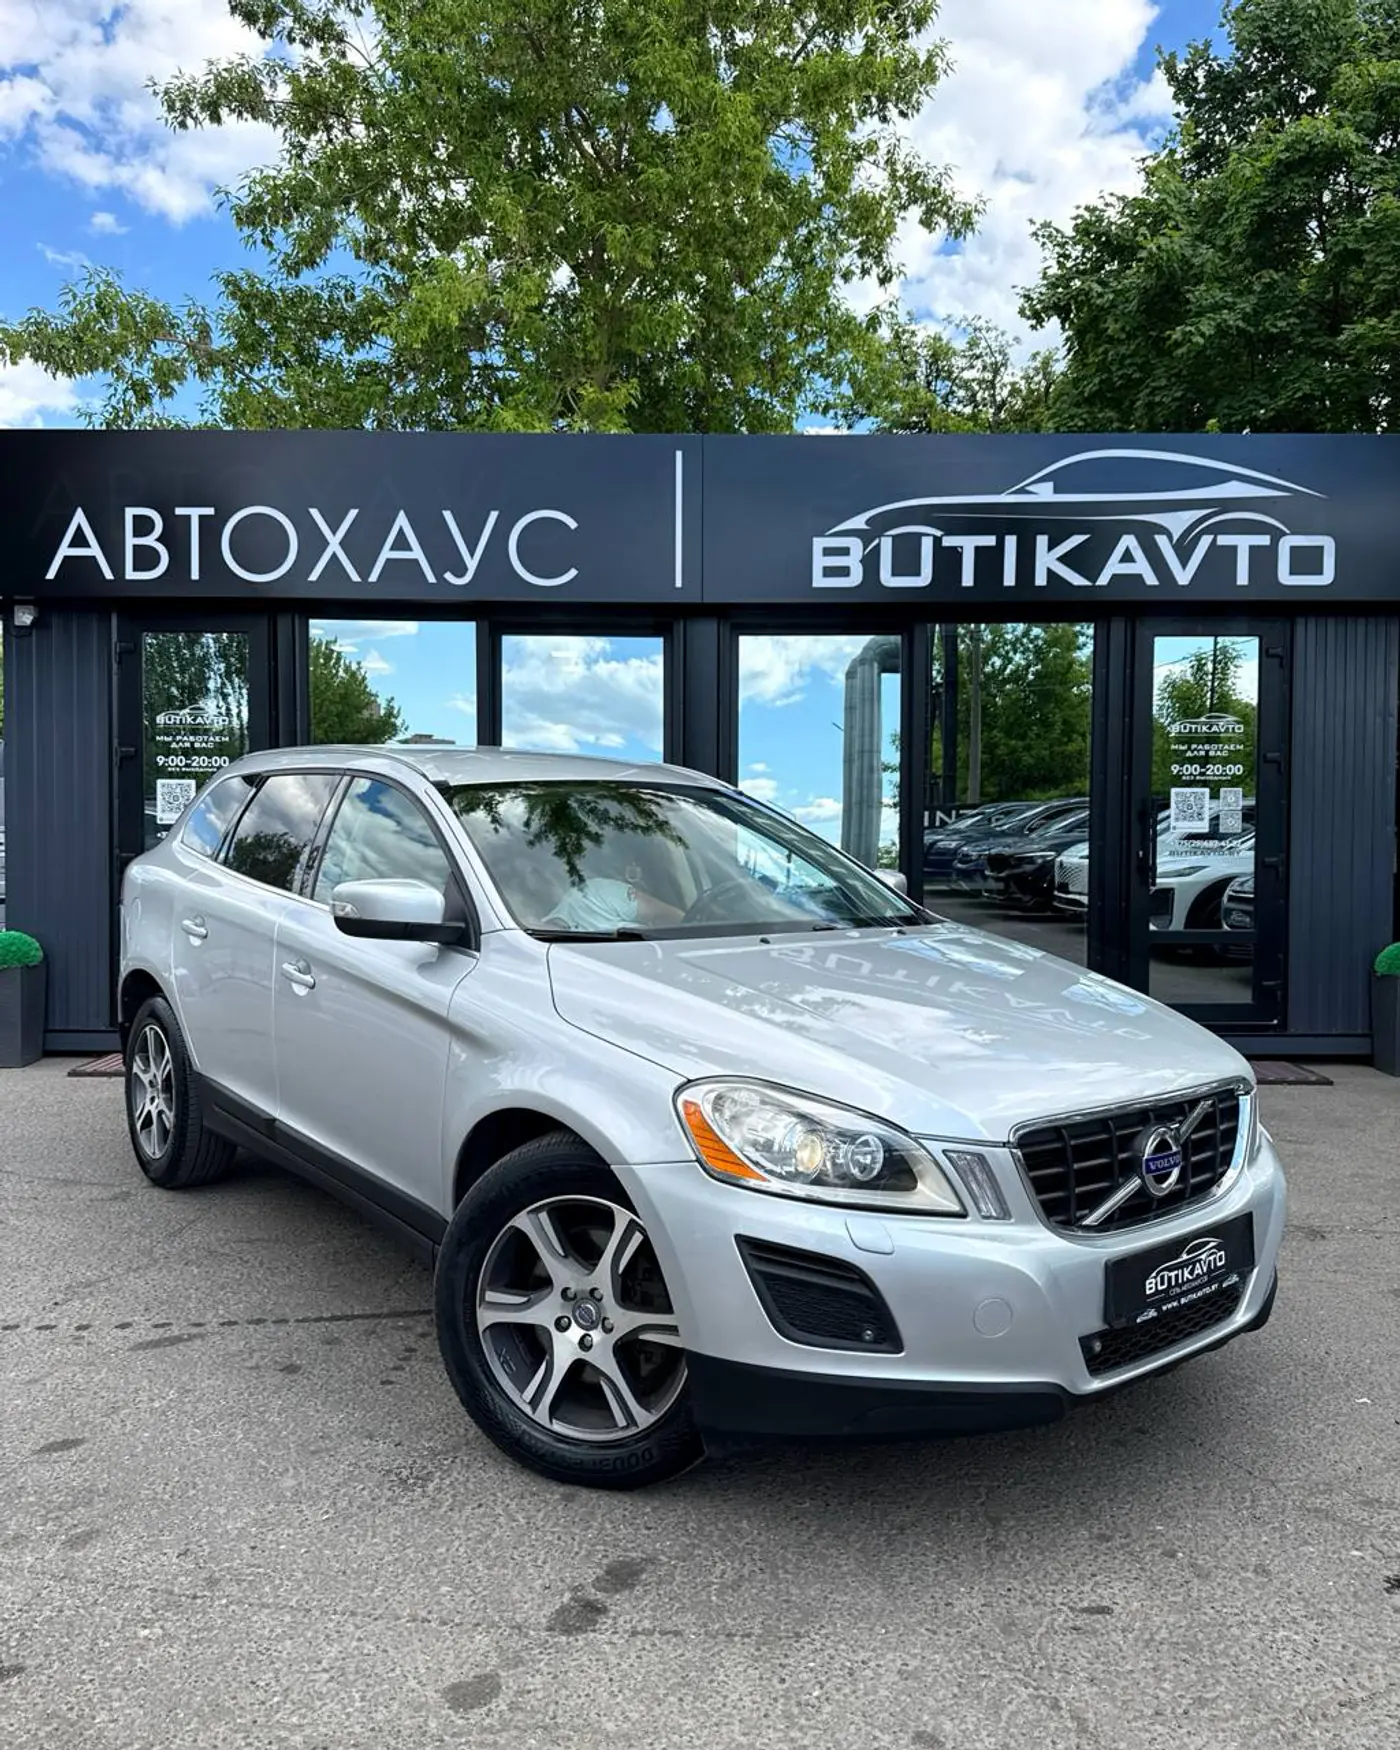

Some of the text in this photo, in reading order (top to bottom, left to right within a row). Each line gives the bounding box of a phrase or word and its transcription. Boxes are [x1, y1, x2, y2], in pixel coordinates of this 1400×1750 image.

[45, 506, 579, 587] АВТОХАУС
[811, 533, 1337, 588] BUTIKAVTO
[1171, 723, 1244, 733] BUTIKAVTO
[156, 756, 229, 766] 9:00-20:00
[1171, 764, 1243, 775] 9:00-20:00
[1149, 1155, 1181, 1169] VOLVO
[1145, 1251, 1226, 1295] BUTIKAVTO
